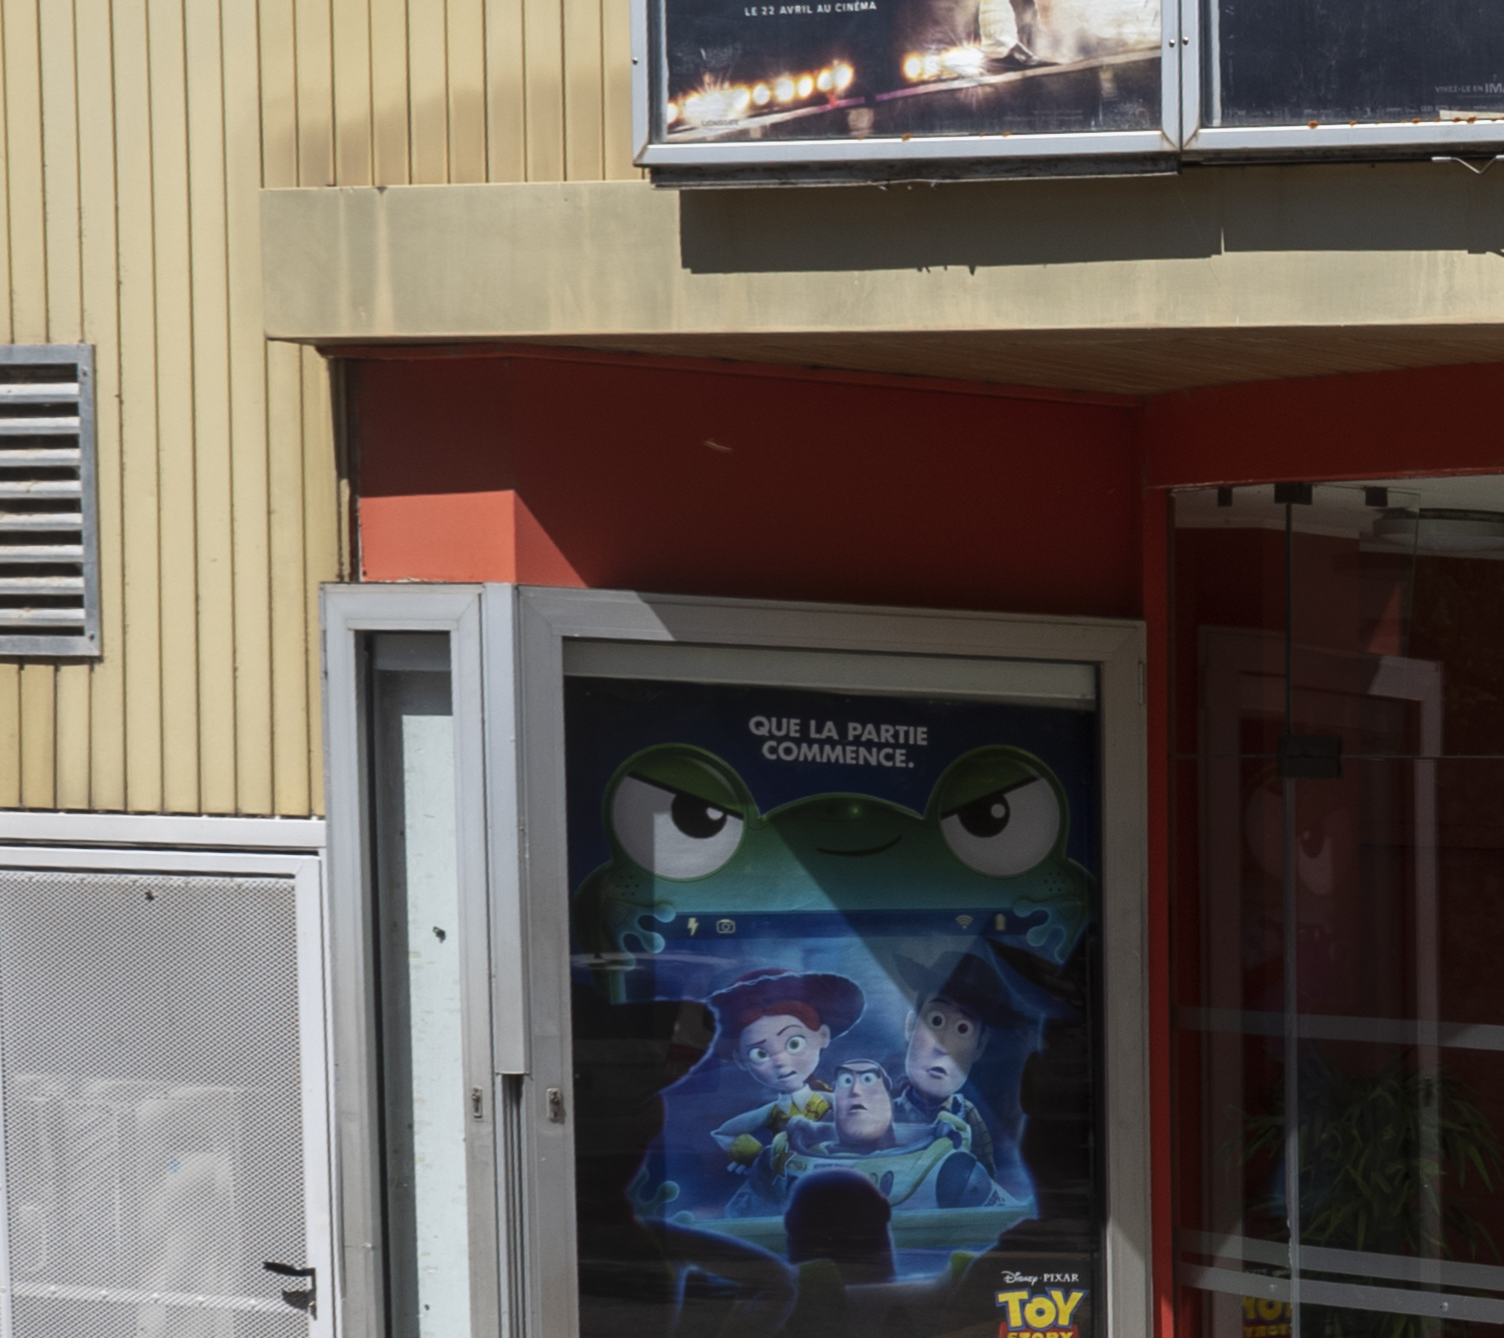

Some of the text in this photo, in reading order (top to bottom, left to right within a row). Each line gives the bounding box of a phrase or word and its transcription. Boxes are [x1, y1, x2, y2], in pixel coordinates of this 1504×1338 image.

[745, 0, 876, 16] LE 22 AVRIL AU CINÉMA
[749, 716, 928, 745] QUE LA PARTIE
[762, 741, 914, 768] COMMENCE.
[1043, 1273, 1079, 1282] PIXAR
[995, 1286, 1089, 1331] TOY
